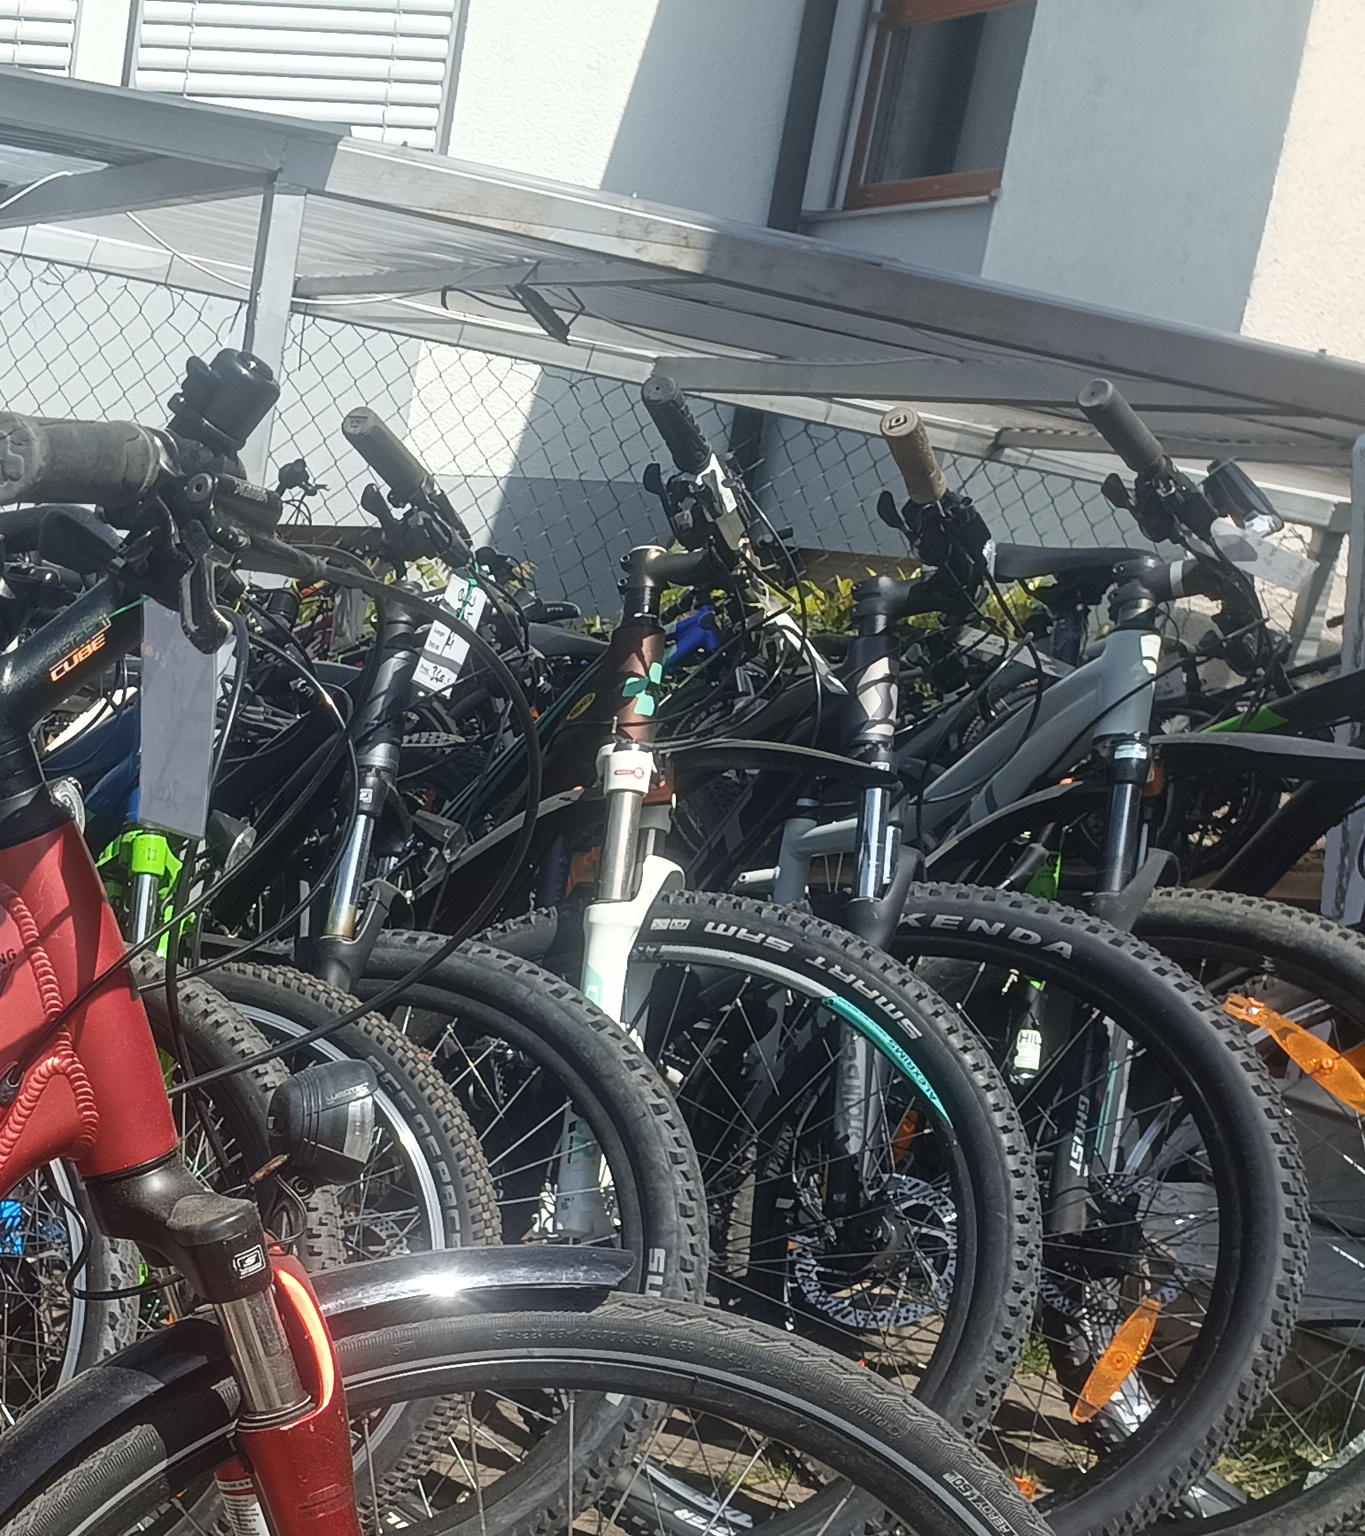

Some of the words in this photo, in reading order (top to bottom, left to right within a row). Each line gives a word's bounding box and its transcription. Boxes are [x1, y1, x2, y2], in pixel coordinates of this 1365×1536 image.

[50, 633, 106, 682] CUBE
[703, 920, 795, 954] SAM
[897, 912, 1074, 960] KENDA
[805, 955, 924, 1040] SMART
[1069, 1094, 1091, 1177] GHOST
